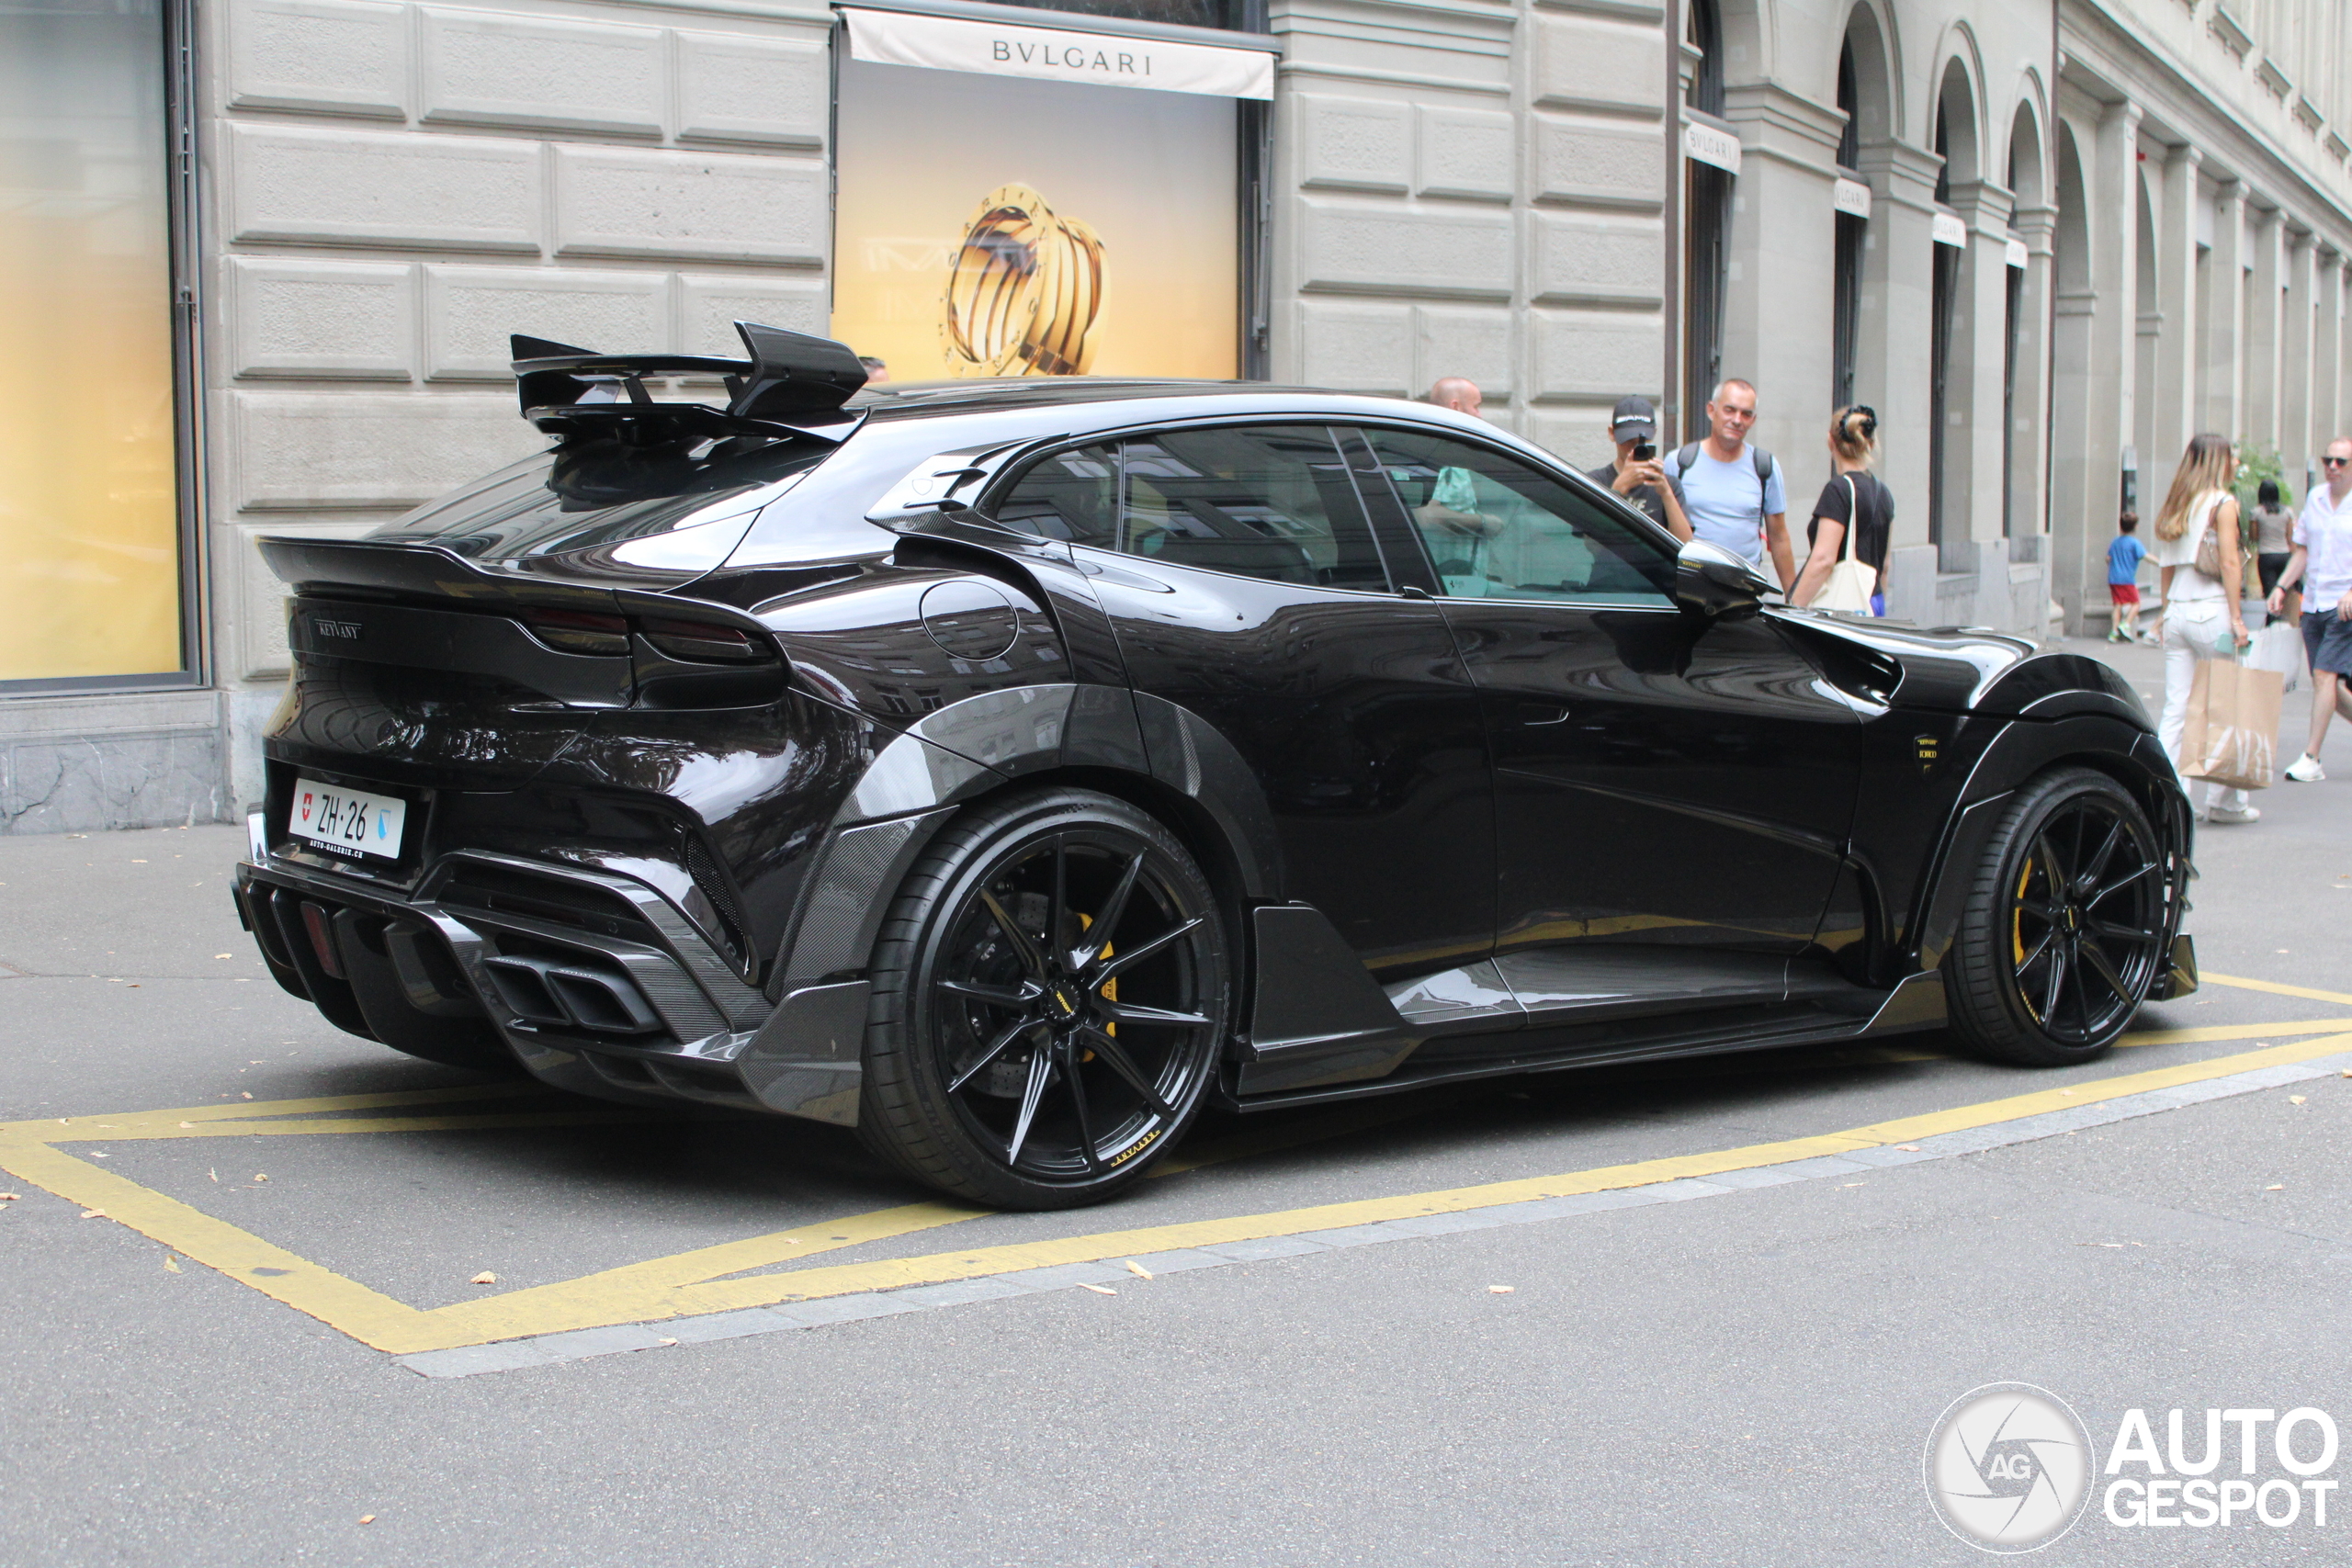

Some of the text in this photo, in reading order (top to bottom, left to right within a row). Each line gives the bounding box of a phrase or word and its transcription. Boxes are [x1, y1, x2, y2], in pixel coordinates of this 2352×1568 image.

[992, 39, 1151, 76] BVLGARI
[1689, 130, 1733, 161] BVLGARI
[1836, 186, 1864, 209] VLGARI
[317, 621, 359, 639] KEYVANY
[2204, 723, 2274, 784] ZARA
[309, 839, 364, 860] AUTO-GALERIE.CH
[1113, 1131, 1159, 1166] KEYVANY
